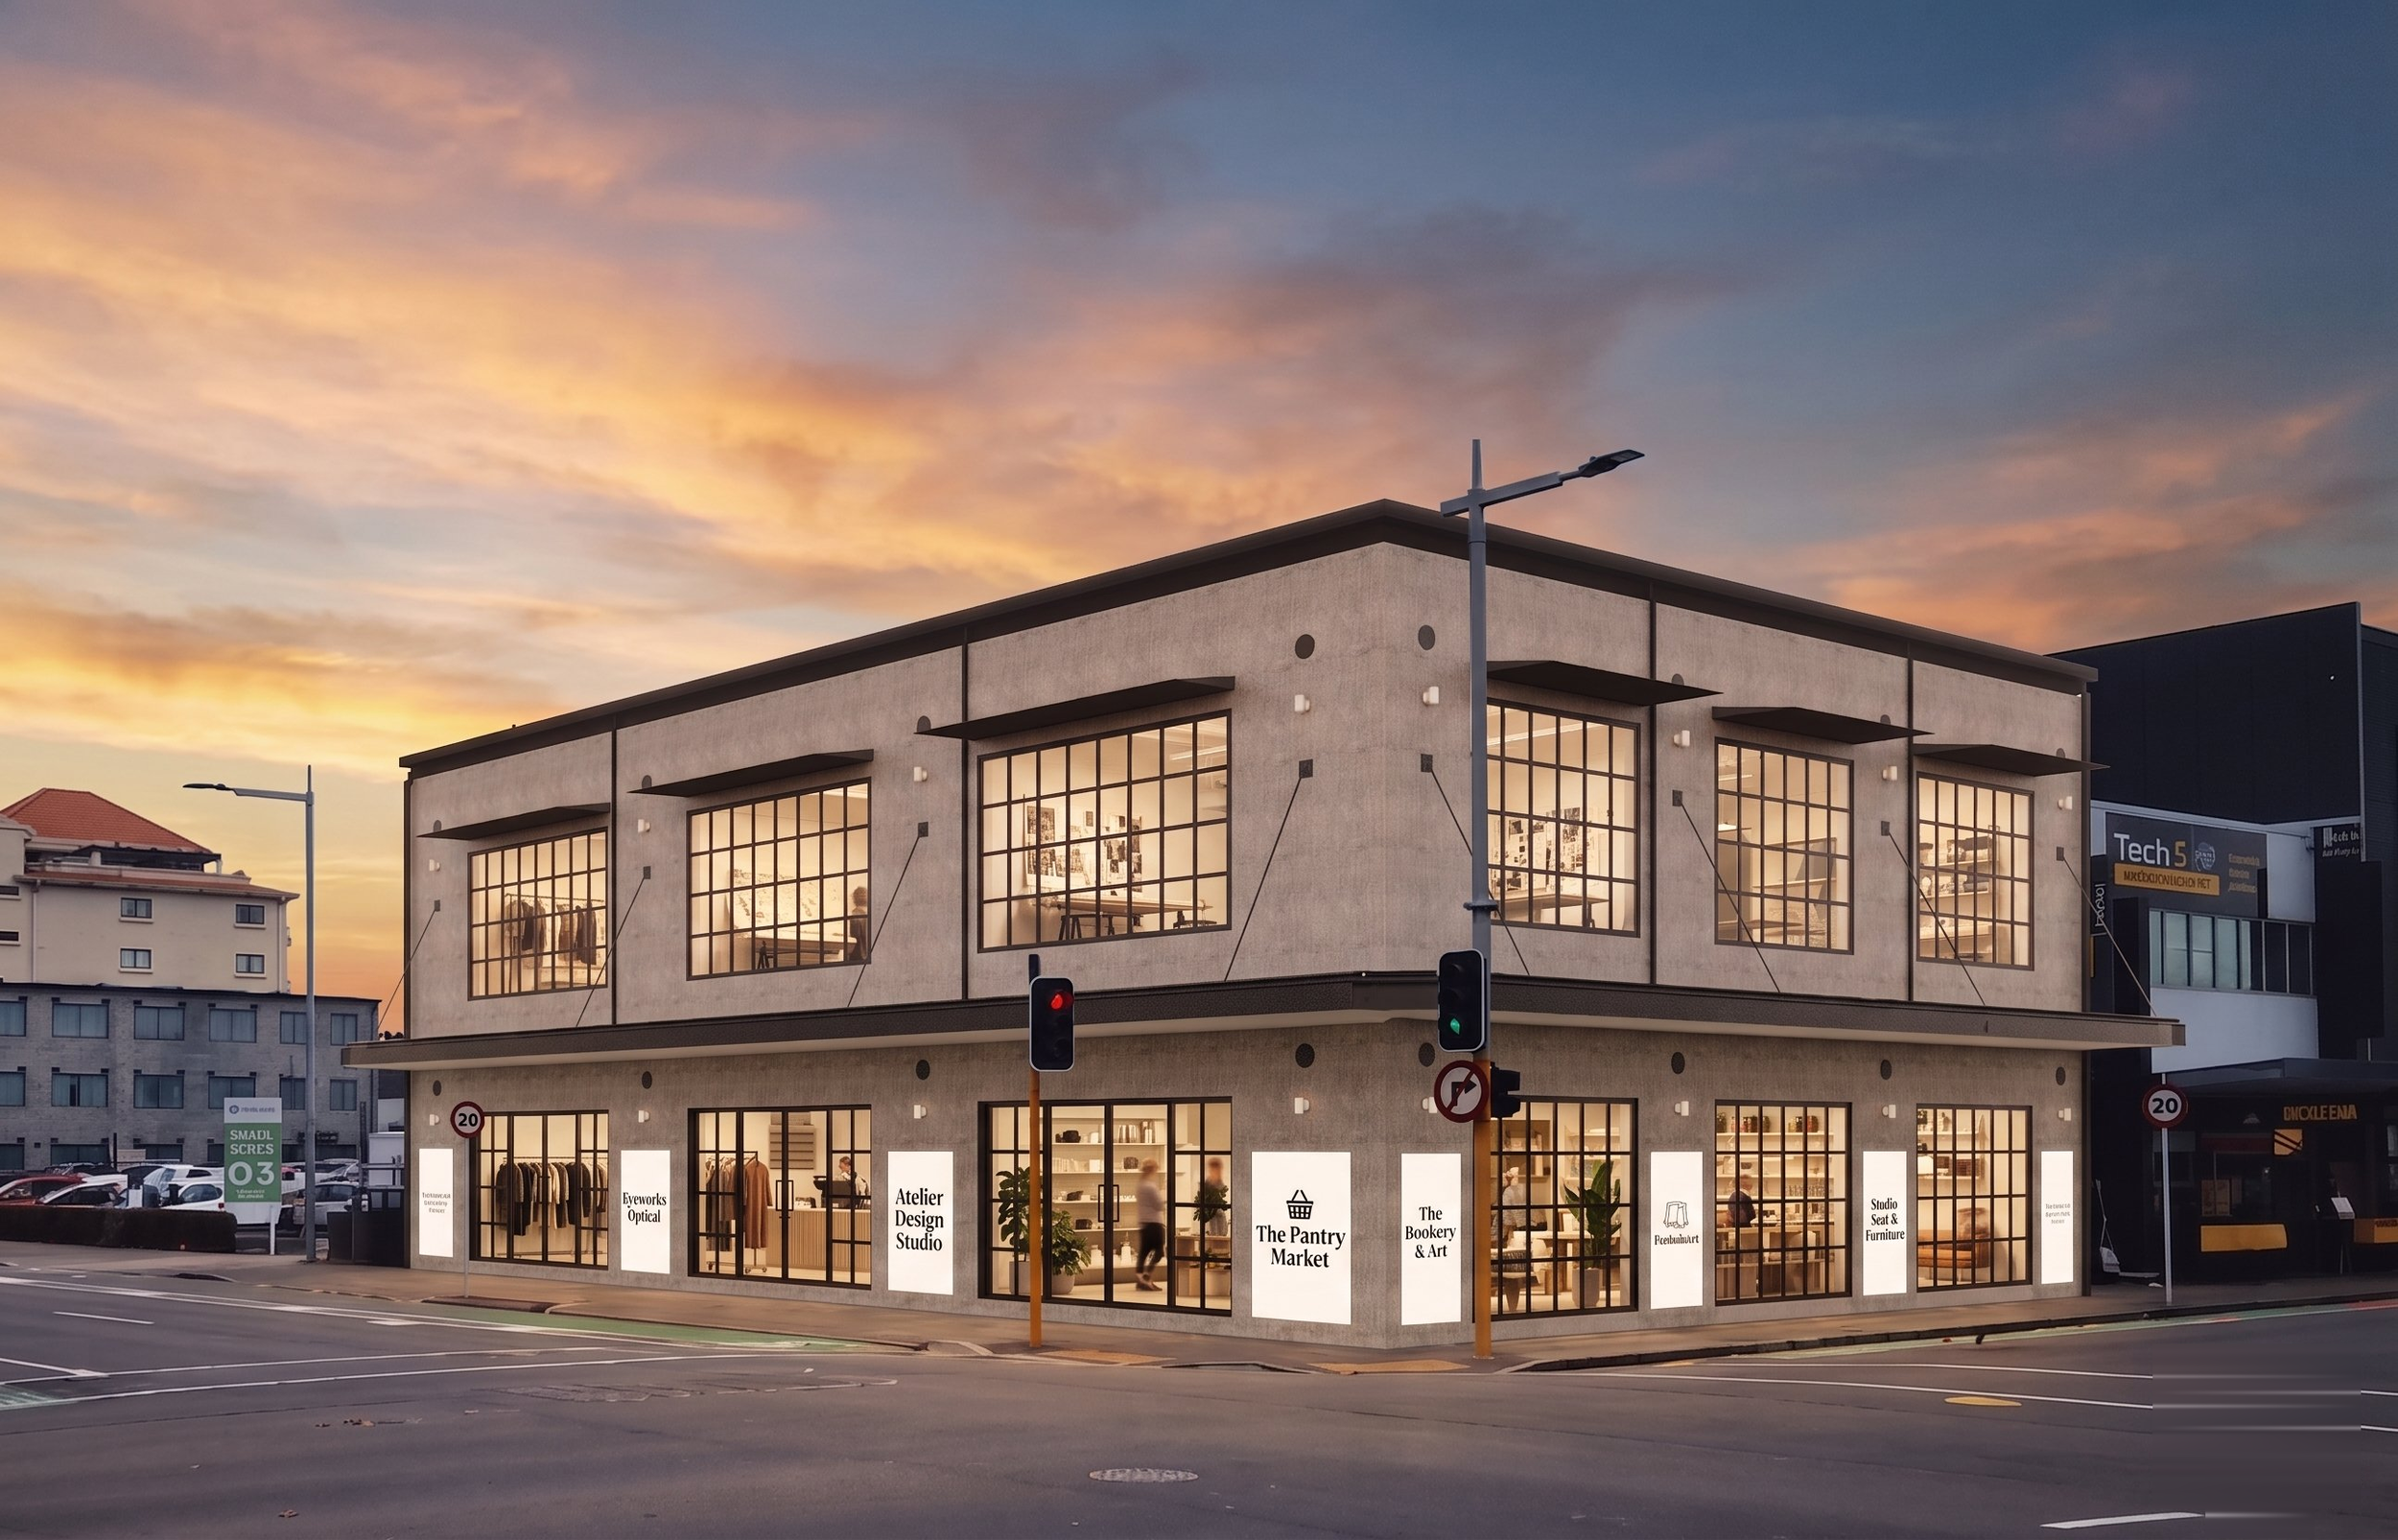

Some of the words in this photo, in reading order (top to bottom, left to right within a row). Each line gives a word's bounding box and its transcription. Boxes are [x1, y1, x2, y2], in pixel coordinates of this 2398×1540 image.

[2114, 832, 2170, 866] Tech
[2174, 841, 2187, 868] 5
[2151, 1098, 2178, 1113] 20
[458, 1112, 479, 1127] 20
[230, 1144, 274, 1155] SCRES
[623, 1192, 667, 1208] Eyeworks
[895, 1187, 944, 1205] Atelier
[1870, 1198, 1898, 1210] Studio
[627, 1209, 661, 1225] Optical
[895, 1209, 944, 1232] Design
[1419, 1205, 1443, 1221] The
[1870, 1214, 1889, 1225] Seat
[1891, 1212, 1898, 1225] &
[896, 1232, 943, 1251] Studio
[1256, 1225, 1286, 1243] The
[1290, 1225, 1346, 1250] Pantry
[1405, 1225, 1456, 1242] Bookery
[1866, 1228, 1905, 1241] Furniture
[1271, 1248, 1329, 1268] Market
[1415, 1244, 1425, 1259] &
[1427, 1244, 1447, 1258] Art
